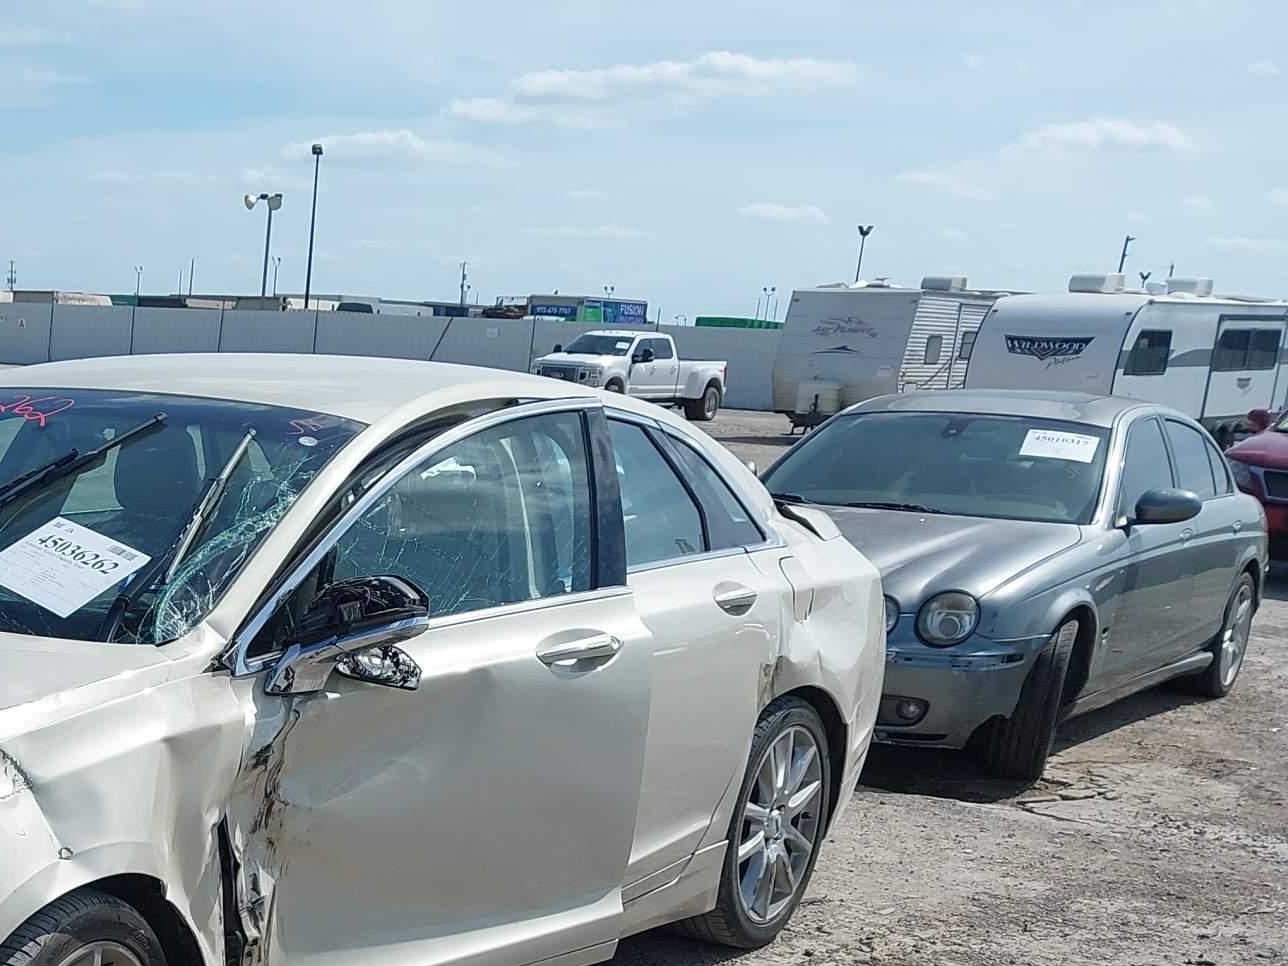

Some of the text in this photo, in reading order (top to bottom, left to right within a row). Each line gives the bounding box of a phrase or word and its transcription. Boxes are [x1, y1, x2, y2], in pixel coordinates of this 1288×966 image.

[620, 304, 644, 316] FUSION
[1007, 340, 1086, 350] WILDWOOD
[37, 534, 120, 576] 45036262
